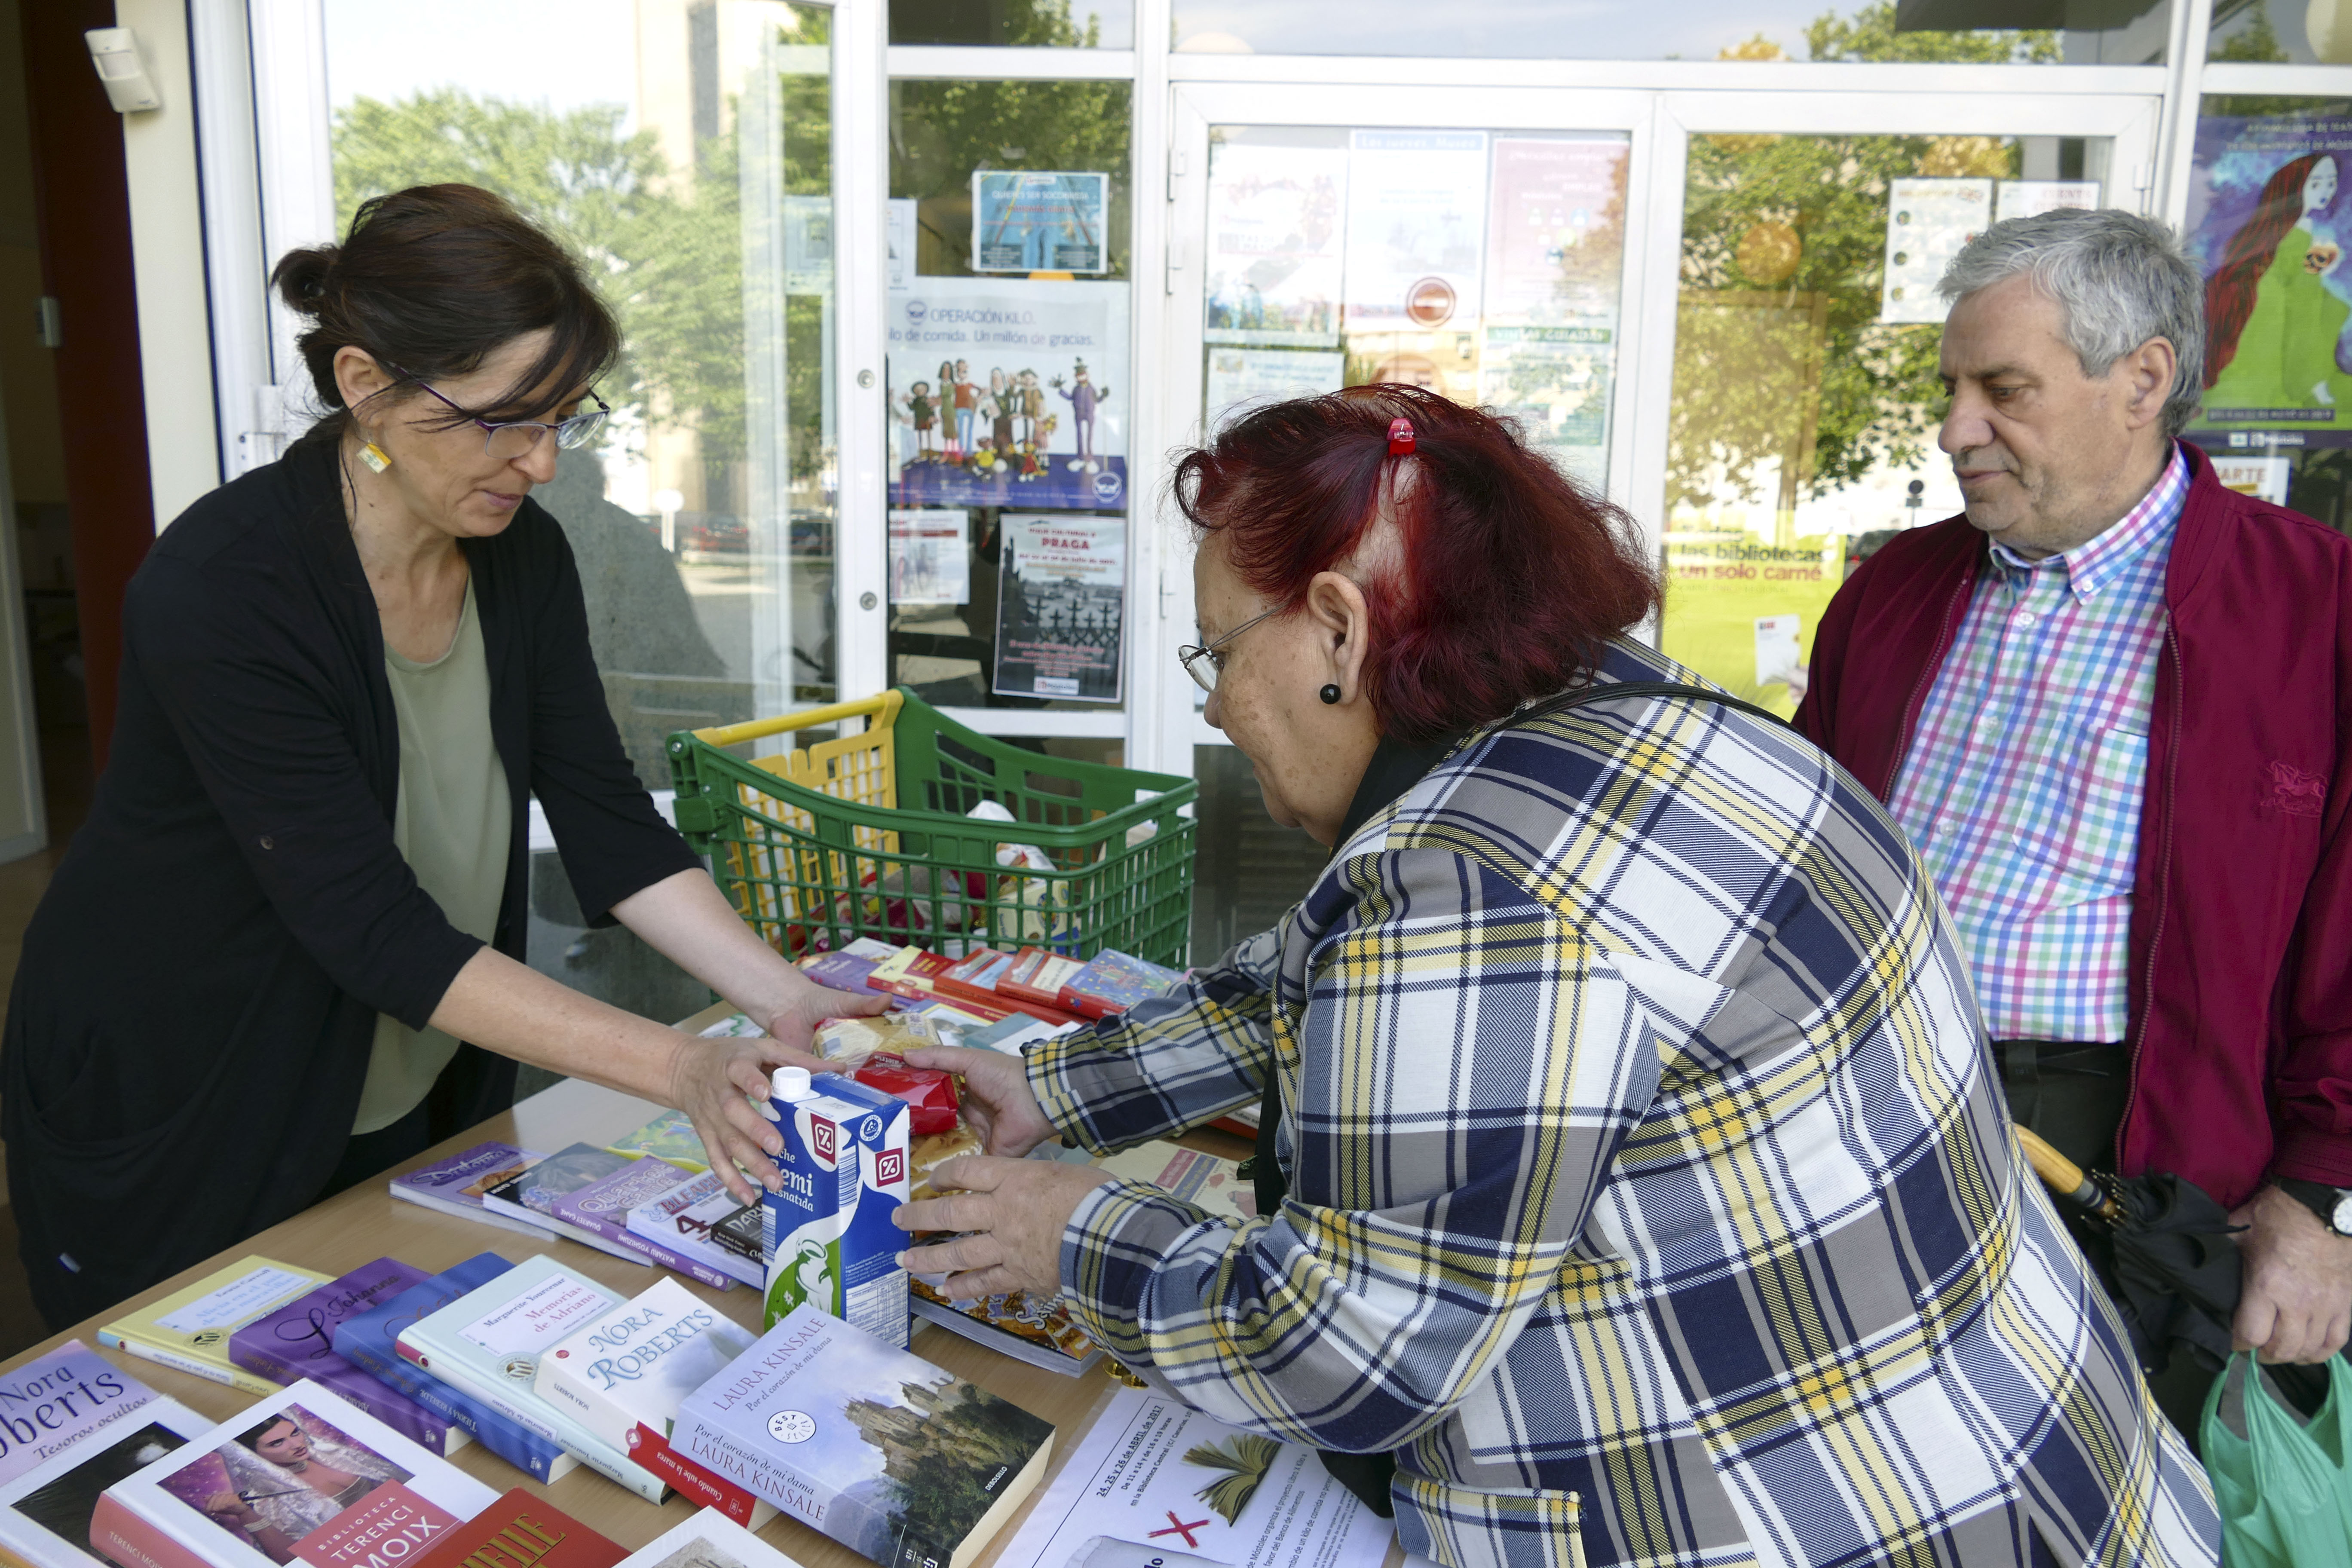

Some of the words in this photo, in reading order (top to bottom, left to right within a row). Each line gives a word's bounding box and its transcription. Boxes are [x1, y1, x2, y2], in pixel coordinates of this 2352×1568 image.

[930, 307, 1003, 323] OPERACIÓN
[905, 328, 920, 341] de
[974, 329, 991, 342] Un
[2218, 466, 2266, 483] ARTE
[1042, 538, 1090, 549] PRAGA
[1681, 544, 1710, 556] las
[1716, 544, 1824, 562] bibliotecas
[1714, 564, 1757, 580] solo
[1764, 564, 1822, 582] carné
[776, 1148, 796, 1164] che
[559, 1208, 576, 1221] GAME
[576, 1216, 601, 1231] QUARTET
[676, 1215, 712, 1234] 4
[725, 1206, 763, 1233] DAR
[617, 1234, 649, 1254] YOSHIZUMI
[650, 1247, 676, 1265] WATARU
[483, 1301, 528, 1328] Marguerite
[525, 1277, 566, 1302] Yourcenar
[524, 1286, 583, 1320] Memorias
[534, 1321, 551, 1333] de
[549, 1293, 597, 1323] Adriano
[588, 1308, 664, 1353] NORA
[587, 1309, 713, 1391] ROBERTS
[712, 1369, 770, 1412] LAURA
[762, 1317, 827, 1370] KINSALE
[744, 1398, 761, 1412] Por
[761, 1390, 770, 1400] el
[769, 1368, 796, 1395] corazón
[794, 1362, 804, 1371] de
[803, 1352, 815, 1365] mi
[812, 1336, 833, 1355] dama
[0, 1366, 74, 1411] Nora
[553, 1382, 575, 1400] ROBERTS
[420, 1389, 447, 1411] REBELDE
[447, 1406, 453, 1414] Y
[491, 1399, 516, 1418] Adriano
[575, 1395, 590, 1411] NORA
[33, 1426, 94, 1459] Tesoros
[97, 1396, 148, 1428] ocultos
[453, 1409, 477, 1432] TIERNA
[525, 1417, 554, 1439] Memorias
[774, 1414, 796, 1432] BEST
[560, 1438, 591, 1459] Yourcenar
[1096, 1486, 1111, 1497] 24,
[1104, 1475, 1116, 1484] 25
[1115, 1459, 1126, 1469] 26
[1122, 1449, 1133, 1460] de
[1128, 1430, 1147, 1450] ABRIL
[1142, 1421, 1152, 1430] de
[1147, 1405, 1162, 1421] 2017
[1121, 1482, 1131, 1490] De
[1142, 1449, 1152, 1458] de
[1160, 1417, 1173, 1431] horas
[591, 1455, 624, 1479] Marguerite
[656, 1452, 677, 1469] marea
[676, 1464, 683, 1476] la
[694, 1423, 713, 1438] Por
[712, 1433, 723, 1445] el
[723, 1442, 759, 1465] corazón
[760, 1459, 772, 1473] de
[773, 1468, 788, 1481] mi
[788, 1472, 815, 1496] dama
[683, 1470, 698, 1484] sube
[691, 1437, 746, 1479] LAURA
[751, 1469, 826, 1522] KINSALE
[984, 1466, 1008, 1491] DEBOLSILLO
[1130, 1498, 1138, 1507] en
[1137, 1466, 1158, 1493] Biblioteca
[1154, 1447, 1170, 1467] Central
[698, 1480, 723, 1501] Cuando
[1319, 1491, 1327, 1500] no
[1250, 1534, 1268, 1561] Móstoles
[1264, 1512, 1280, 1534] organiza
[1277, 1483, 1293, 1507] proyecto
[1288, 1471, 1299, 1485] Libro
[1296, 1457, 1306, 1467] Kilo
[1288, 1490, 1305, 1517] Alimentos
[1310, 1499, 1324, 1520] comida
[317, 1496, 397, 1551] BIBLIOTECA
[330, 1504, 414, 1562] TERENCI
[1275, 1524, 1289, 1542] Banco
[1303, 1525, 1312, 1537] kilo
[1305, 1519, 1315, 1528] de
[109, 1530, 141, 1559] TERENCI
[352, 1515, 442, 1568] MOIX
[455, 1513, 567, 1568] ELLE
[1271, 1540, 1281, 1554] del
[1293, 1545, 1303, 1555] de
[1298, 1536, 1308, 1546] un
[905, 1548, 914, 1561] 671
[1263, 1552, 1277, 1567] favor
